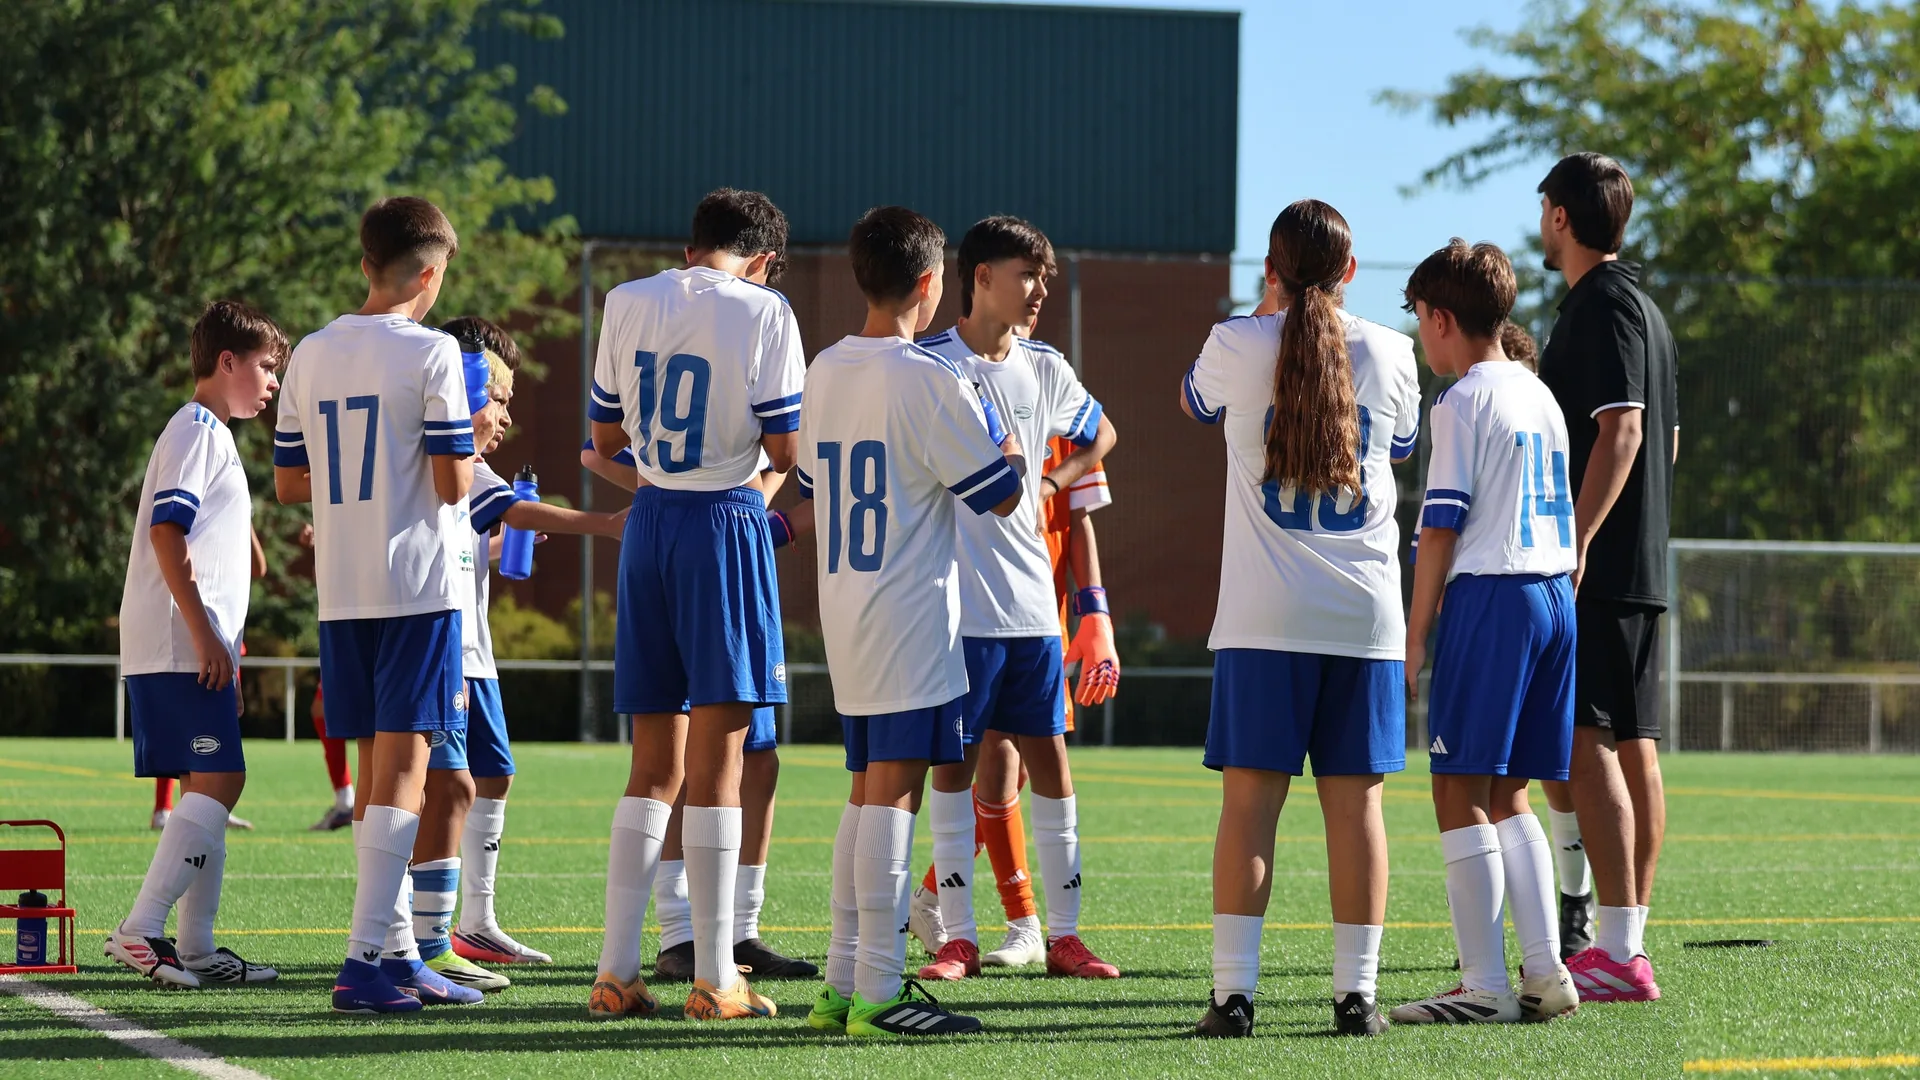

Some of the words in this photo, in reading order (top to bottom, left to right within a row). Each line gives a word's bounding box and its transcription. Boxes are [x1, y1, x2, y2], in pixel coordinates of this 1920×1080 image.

[318, 394, 379, 504] 17
[634, 350, 711, 473] 19
[817, 439, 889, 574] 18
[1515, 431, 1573, 548] 14
